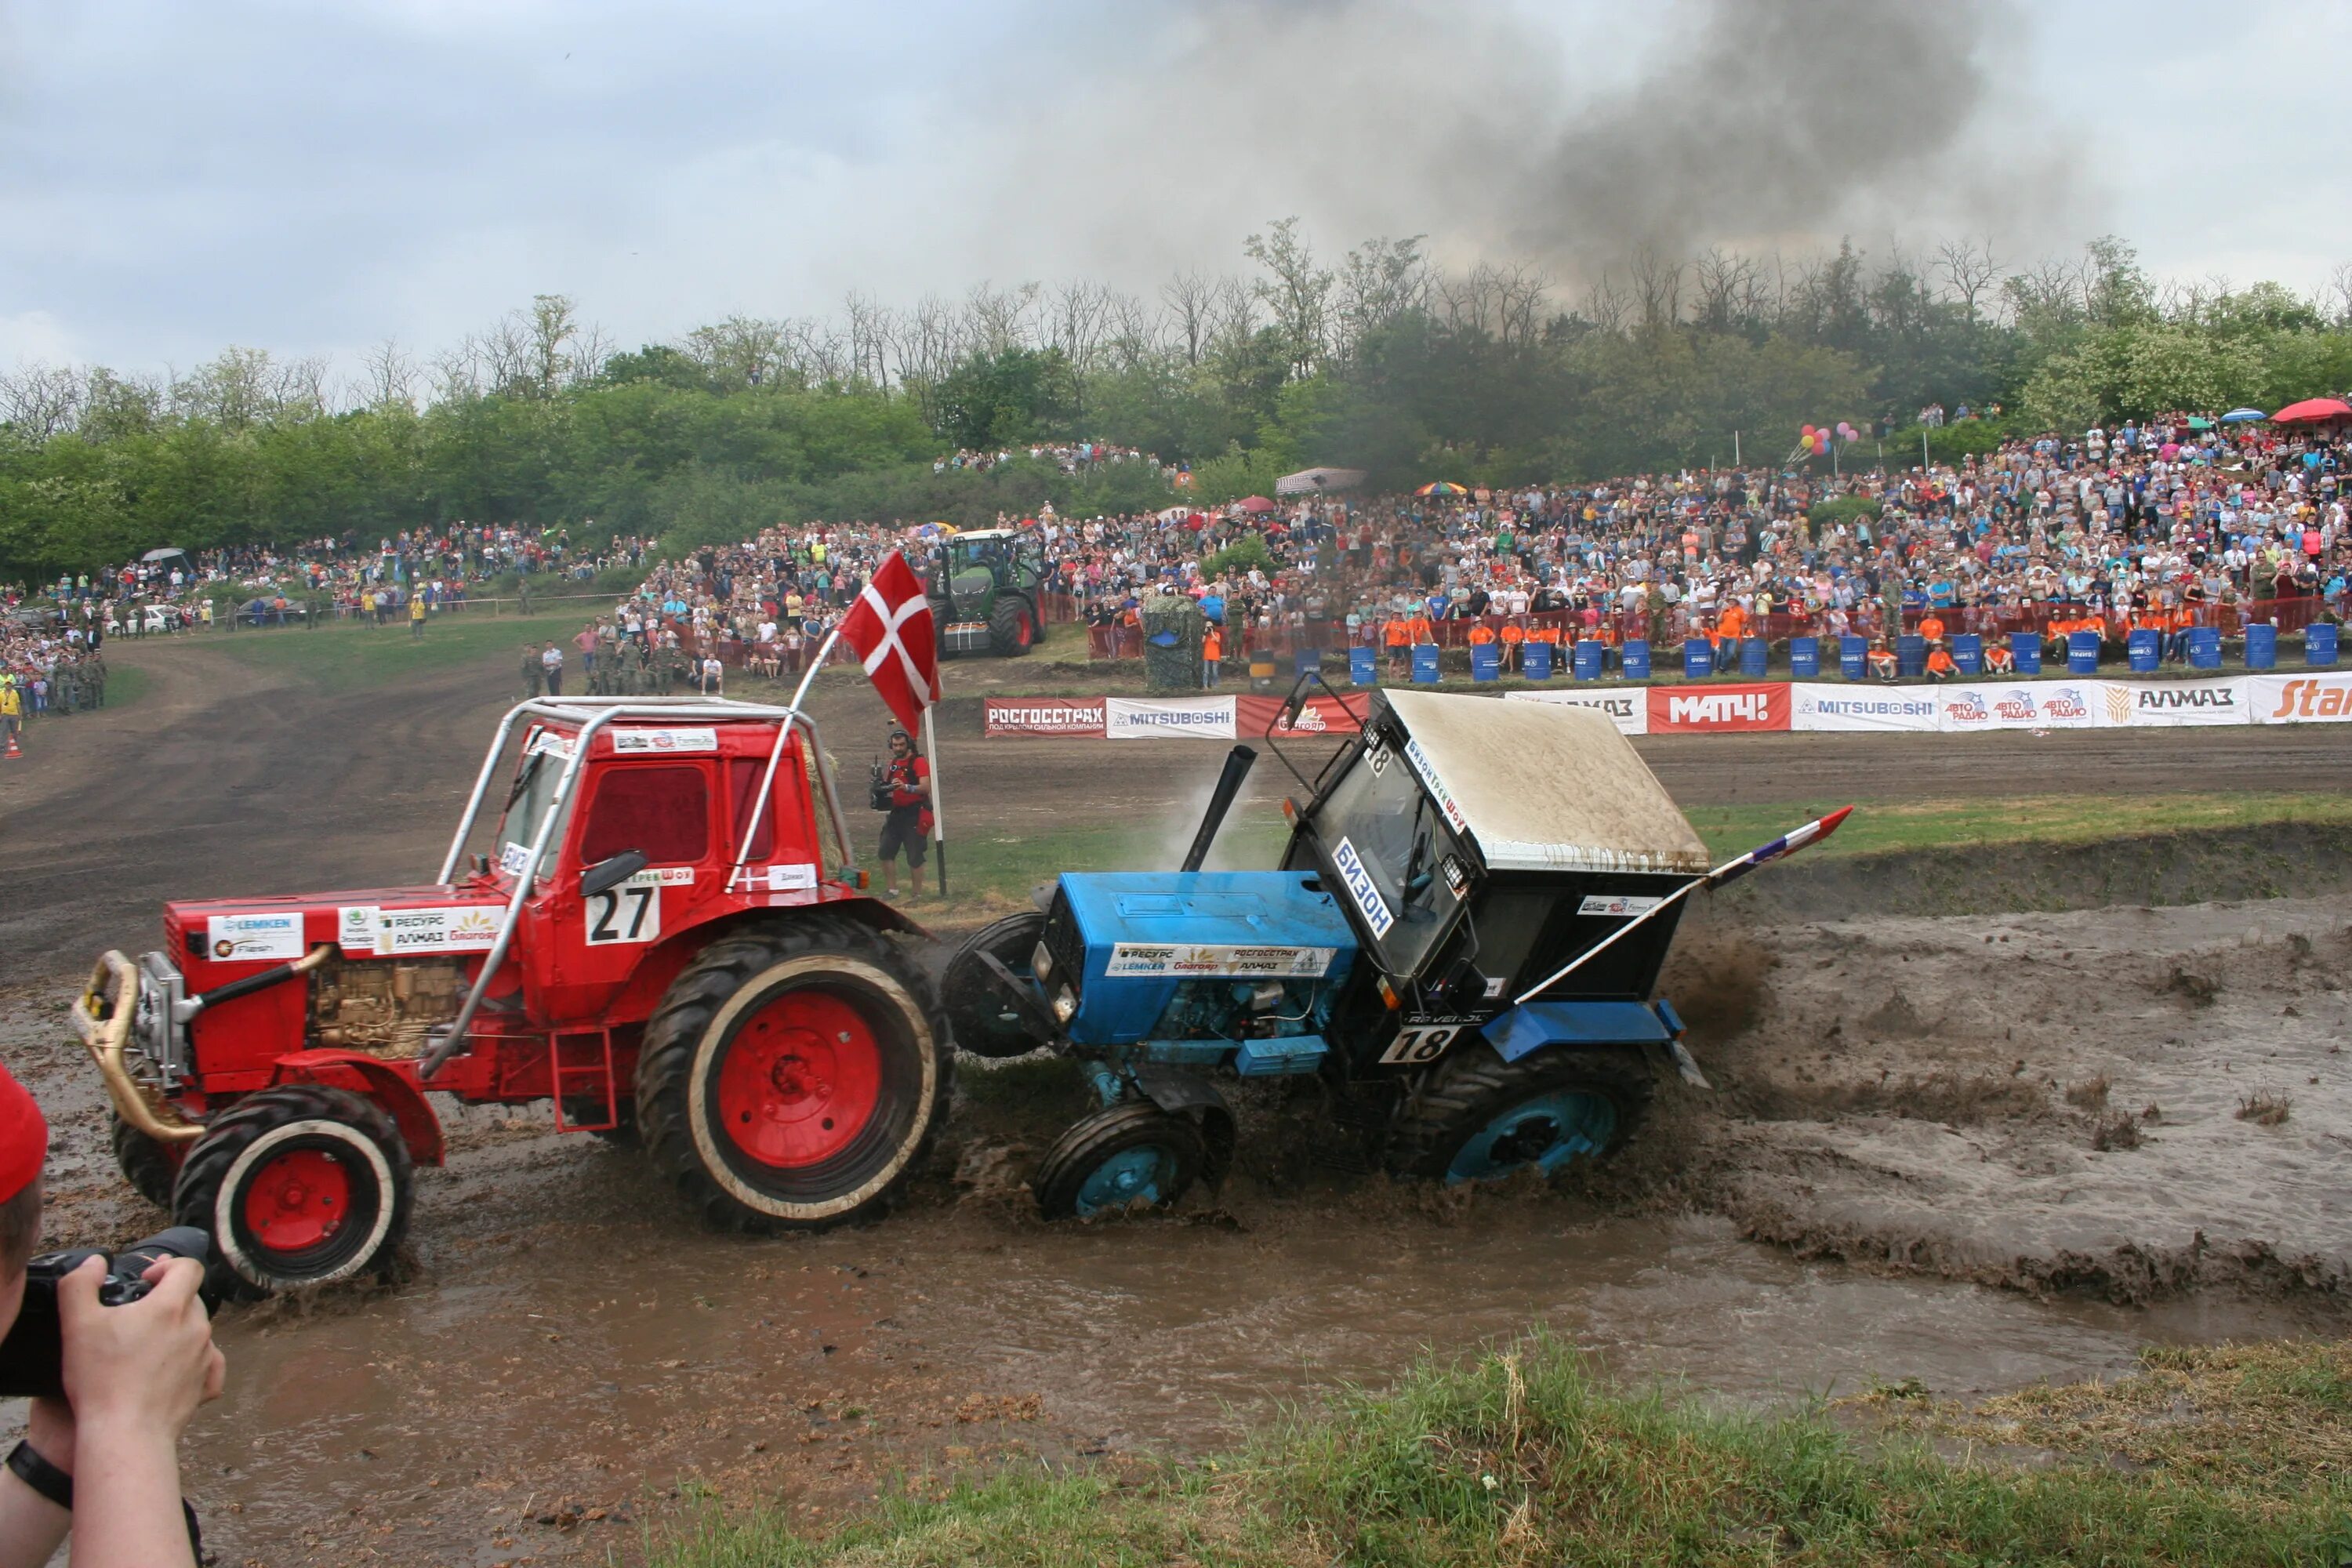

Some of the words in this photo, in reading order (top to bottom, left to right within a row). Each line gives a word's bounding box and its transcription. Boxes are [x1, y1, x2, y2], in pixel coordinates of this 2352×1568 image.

[2138, 688, 2234, 708] АЛМАЗ
[1669, 694, 1768, 723] МАТЧ!
[1817, 700, 1933, 715] MITSUBOSHI
[1944, 703, 1973, 712] АВТО
[1994, 702, 2021, 711] АВТО
[2042, 700, 2071, 710] АВТО
[989, 708, 1103, 724] РОСГОССТРАХ
[1130, 712, 1229, 725] MITSUBOSHI
[1952, 711, 1988, 720] РАДИО
[2001, 710, 2037, 719] РАДИО
[2050, 708, 2086, 717] РАДИО
[1279, 717, 1326, 731] Багояр
[1409, 741, 1432, 779] БИЗОН
[1431, 772, 1447, 803] ТРЕК
[1446, 799, 1465, 827] ШОУ
[1337, 844, 1389, 933] БИЗОН
[591, 887, 653, 941] 27
[238, 919, 291, 930] LEMKEN
[396, 916, 445, 927] РЕСУРС
[397, 932, 444, 944] АЛМАЗ
[1122, 962, 1166, 971] LEMKEN
[1174, 962, 1218, 971] Благояр
[1393, 1029, 1450, 1061] 18
